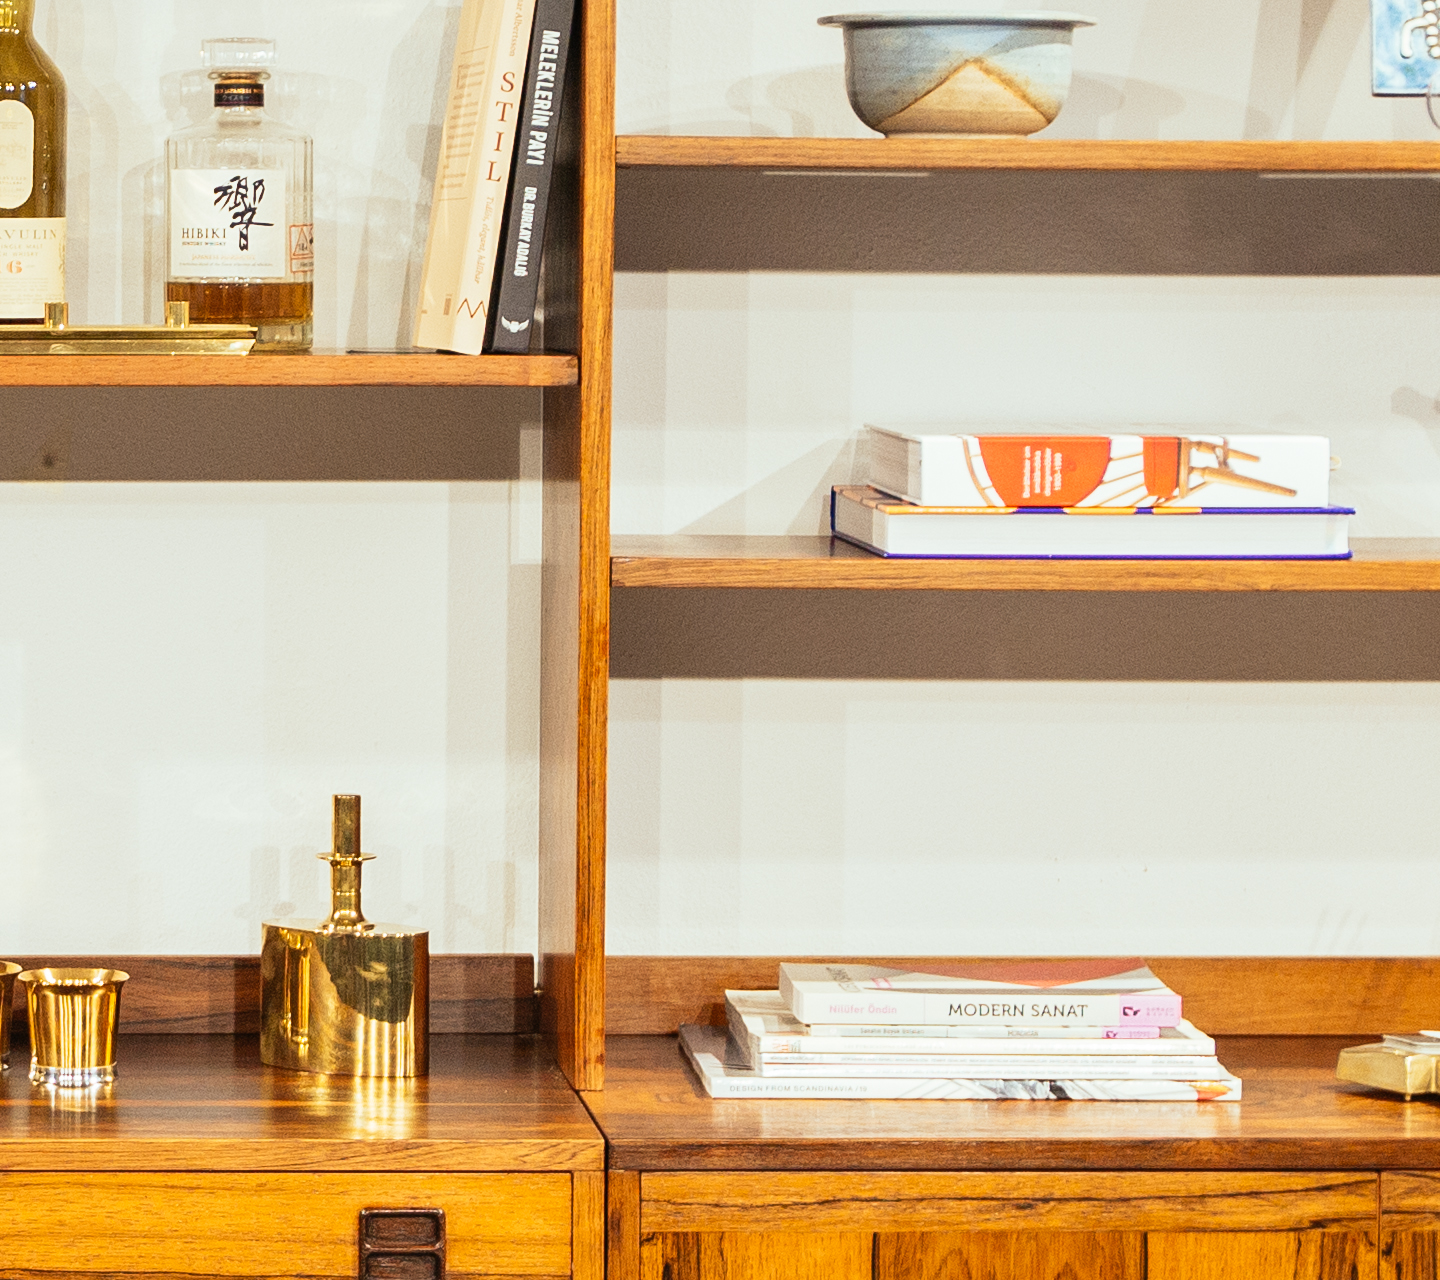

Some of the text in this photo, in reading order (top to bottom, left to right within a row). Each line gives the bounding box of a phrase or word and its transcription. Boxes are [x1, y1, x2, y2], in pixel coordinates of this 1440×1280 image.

[509, 12, 523, 56] Albertsson
[526, 30, 560, 166] MELEKLERİN PAYI
[486, 71, 516, 182] STIL
[181, 228, 226, 239] HIBIKI
[829, 1003, 897, 1015] Nilüfer Öndin
[949, 1003, 1088, 1018] MODERN SANAT
[729, 1084, 763, 1092] DESIGN
[766, 1084, 791, 1092] FROM
[793, 1084, 853, 1093] SCANDINAVIA
